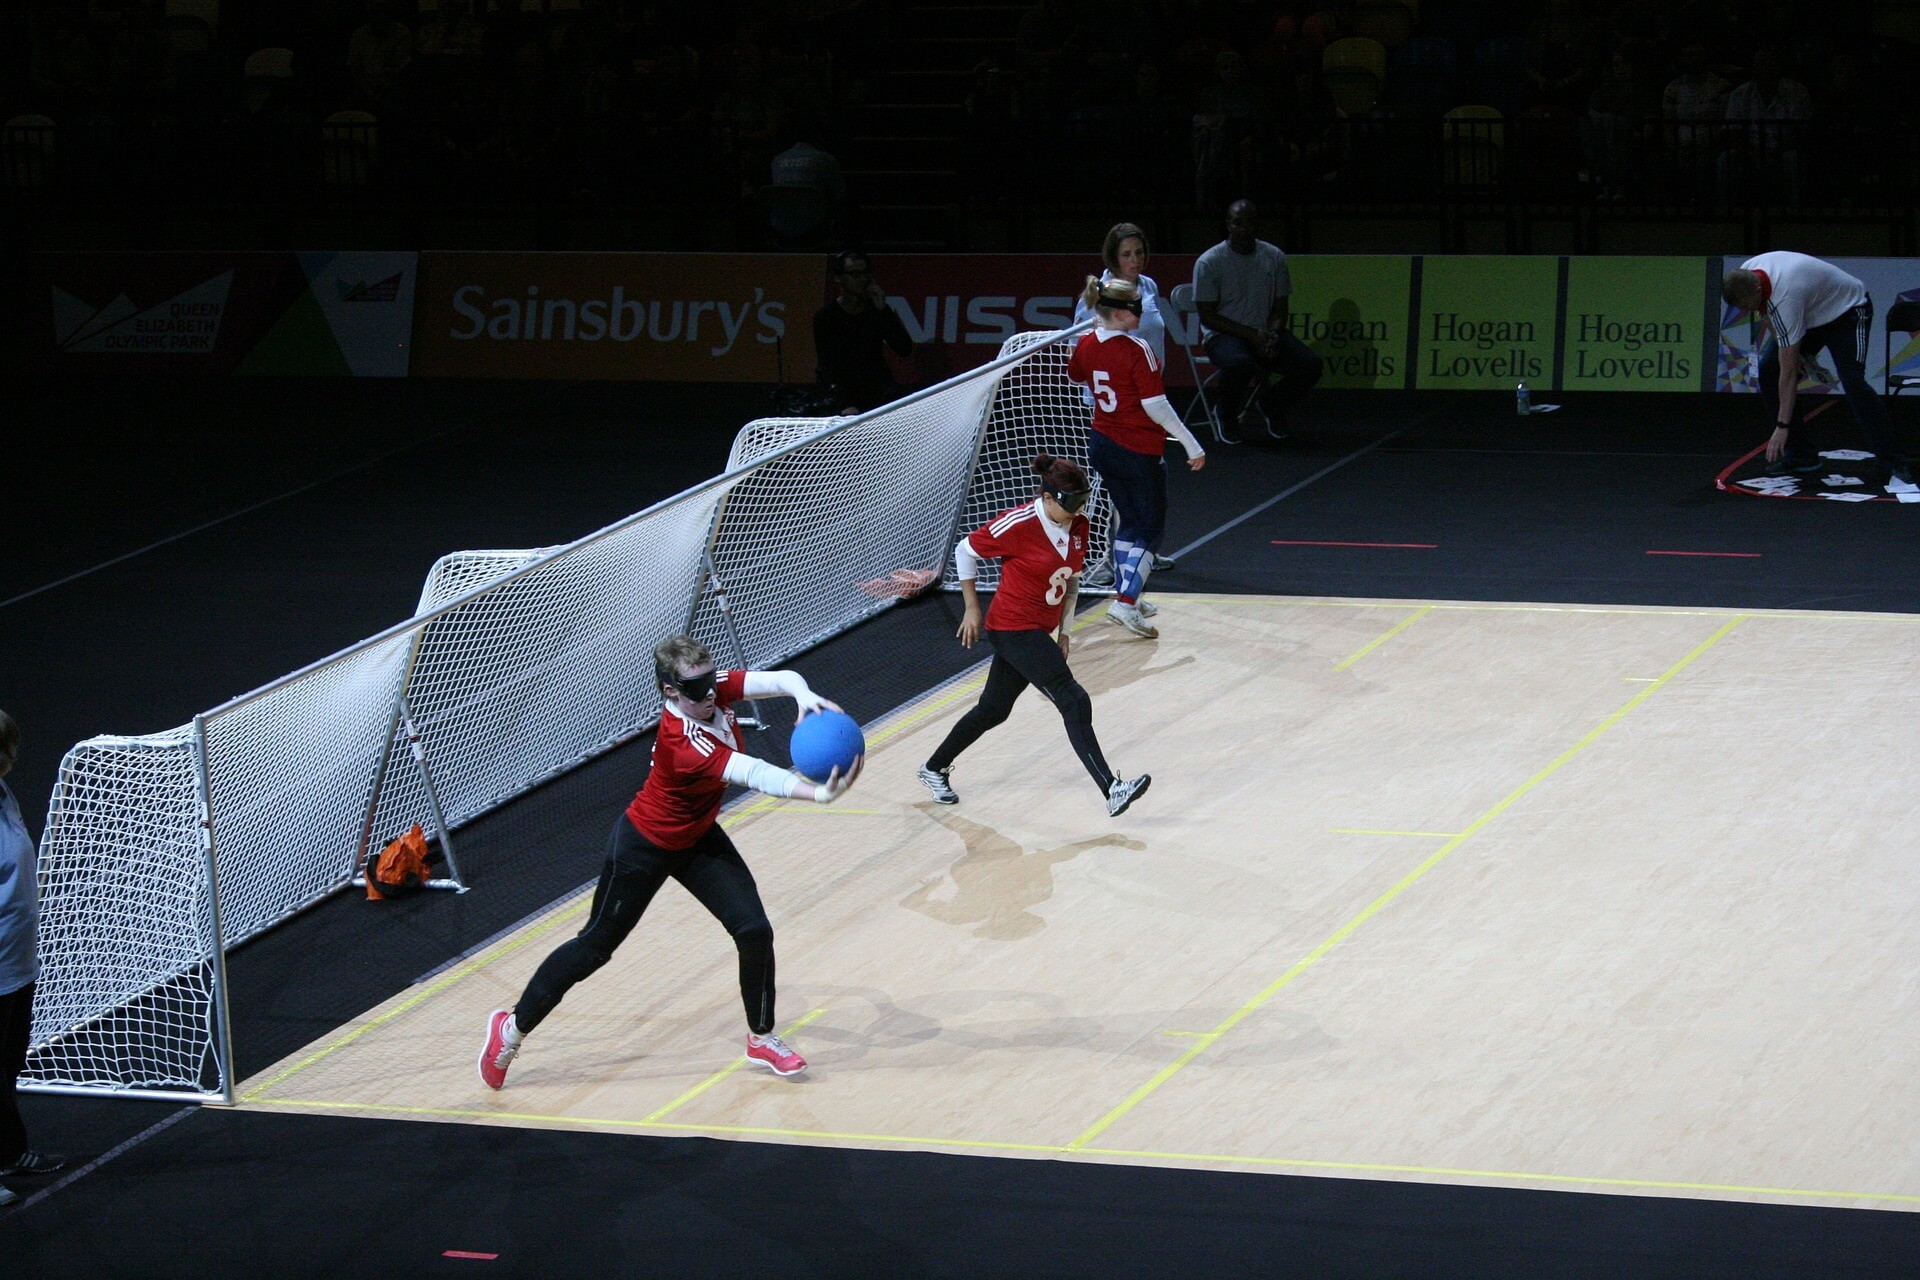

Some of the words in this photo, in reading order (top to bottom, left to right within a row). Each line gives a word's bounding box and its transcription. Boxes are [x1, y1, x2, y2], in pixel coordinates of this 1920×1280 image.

[136, 319, 215, 332] ELIZABETH
[171, 303, 220, 317] QUEEN
[450, 284, 786, 357] Sainsbury's
[886, 295, 1200, 346] NISSN
[106, 335, 167, 349] OLYMPIC
[171, 335, 209, 349] PARK
[1288, 312, 1389, 349] Hogan
[1432, 312, 1537, 350] Hogan
[1577, 314, 1684, 351] Hogan
[1324, 348, 1395, 378] vells
[1429, 348, 1542, 379] Lovells
[1576, 349, 1690, 380] Lovells
[1092, 370, 1118, 413] 5
